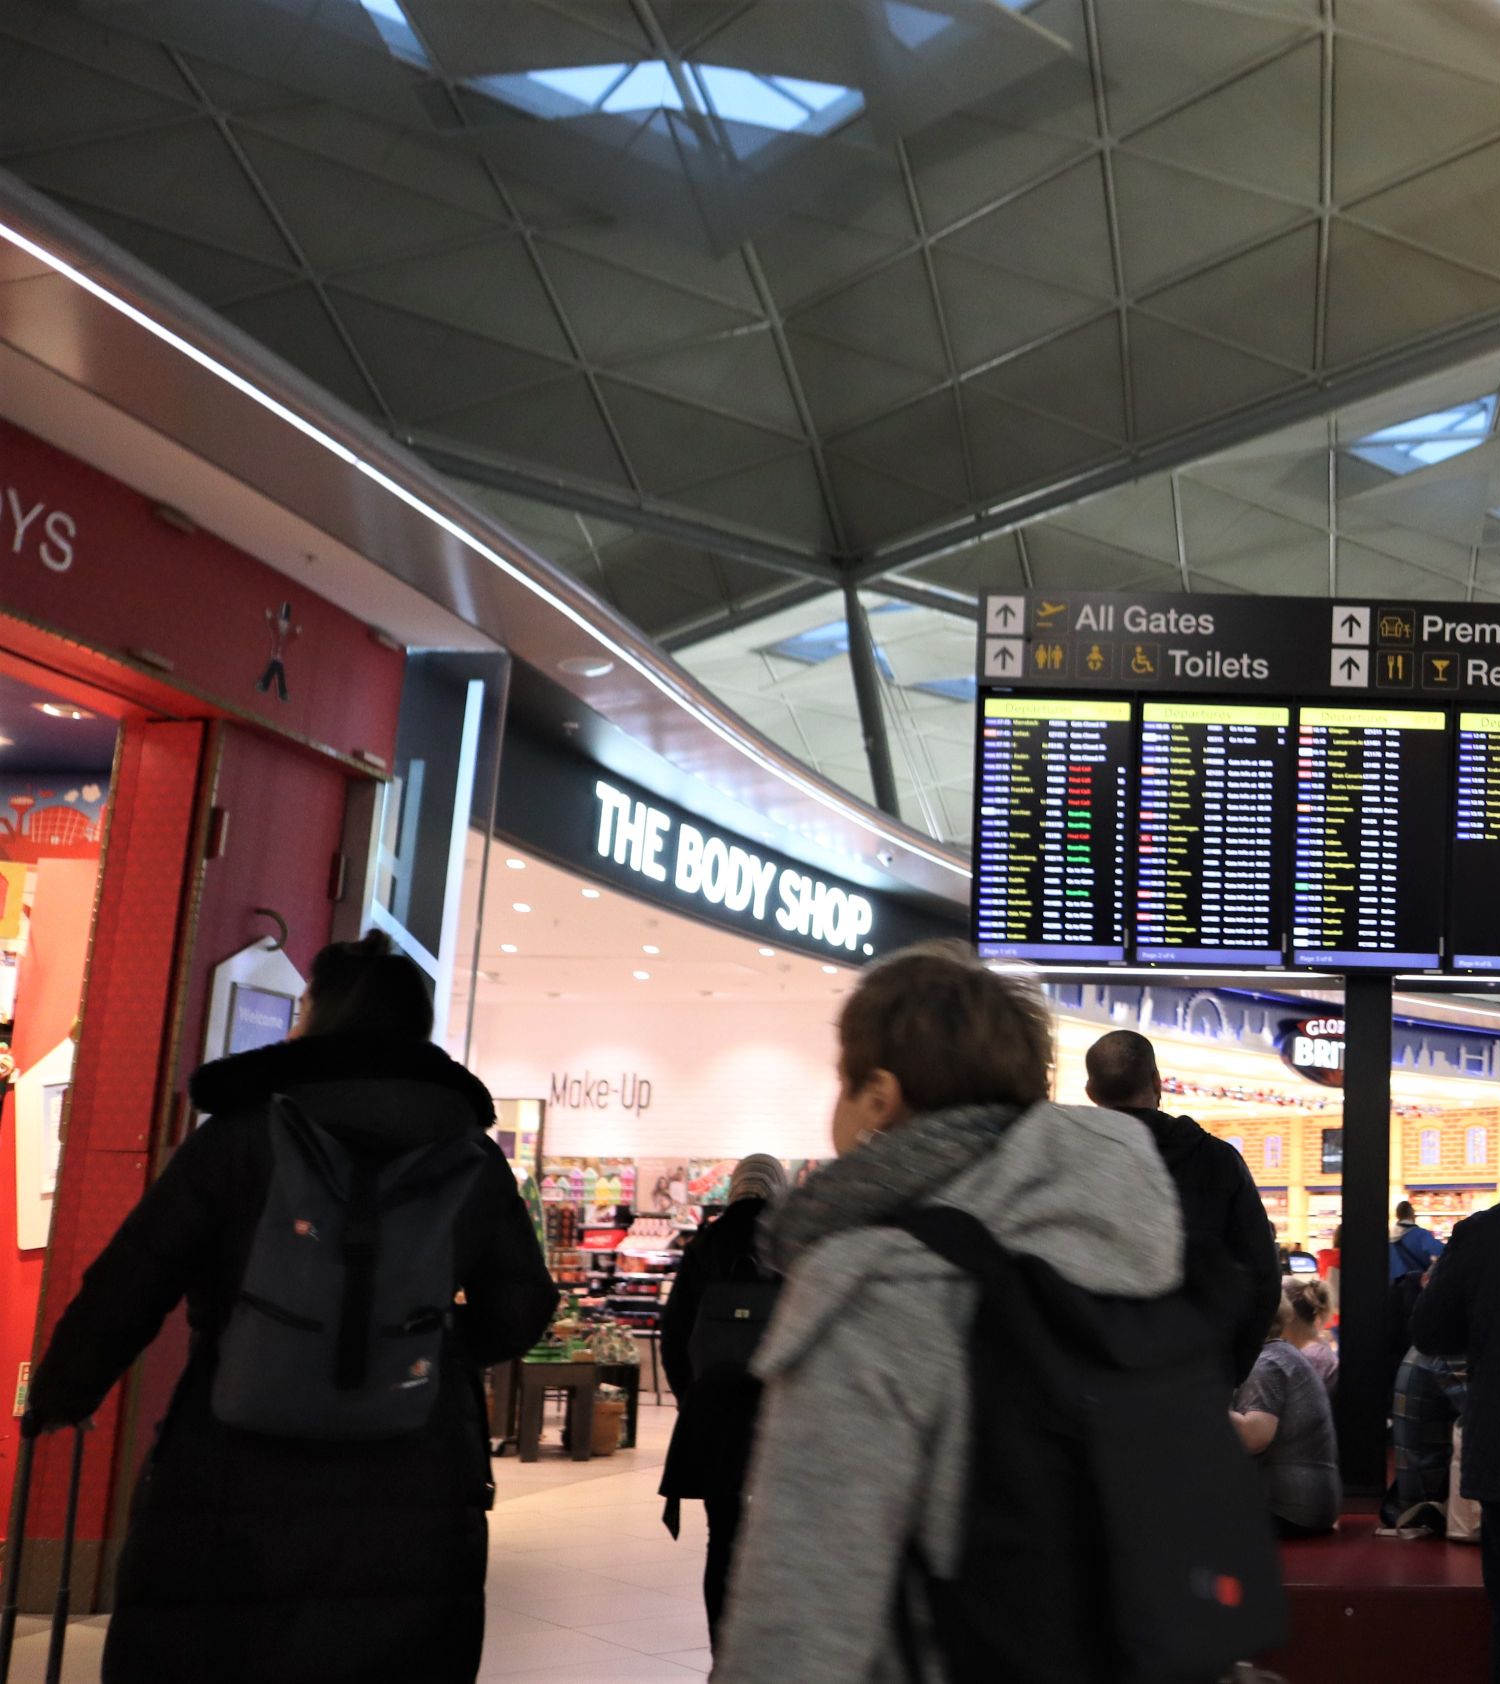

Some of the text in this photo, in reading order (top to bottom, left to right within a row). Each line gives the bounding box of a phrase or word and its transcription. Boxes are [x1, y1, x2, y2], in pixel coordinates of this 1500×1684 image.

[0, 488, 76, 572] YS
[1074, 604, 1215, 635] All Gates
[1167, 646, 1270, 679] Toilets
[595, 780, 874, 956] THE BODY SHOP.
[548, 1069, 652, 1118] Make-Up
